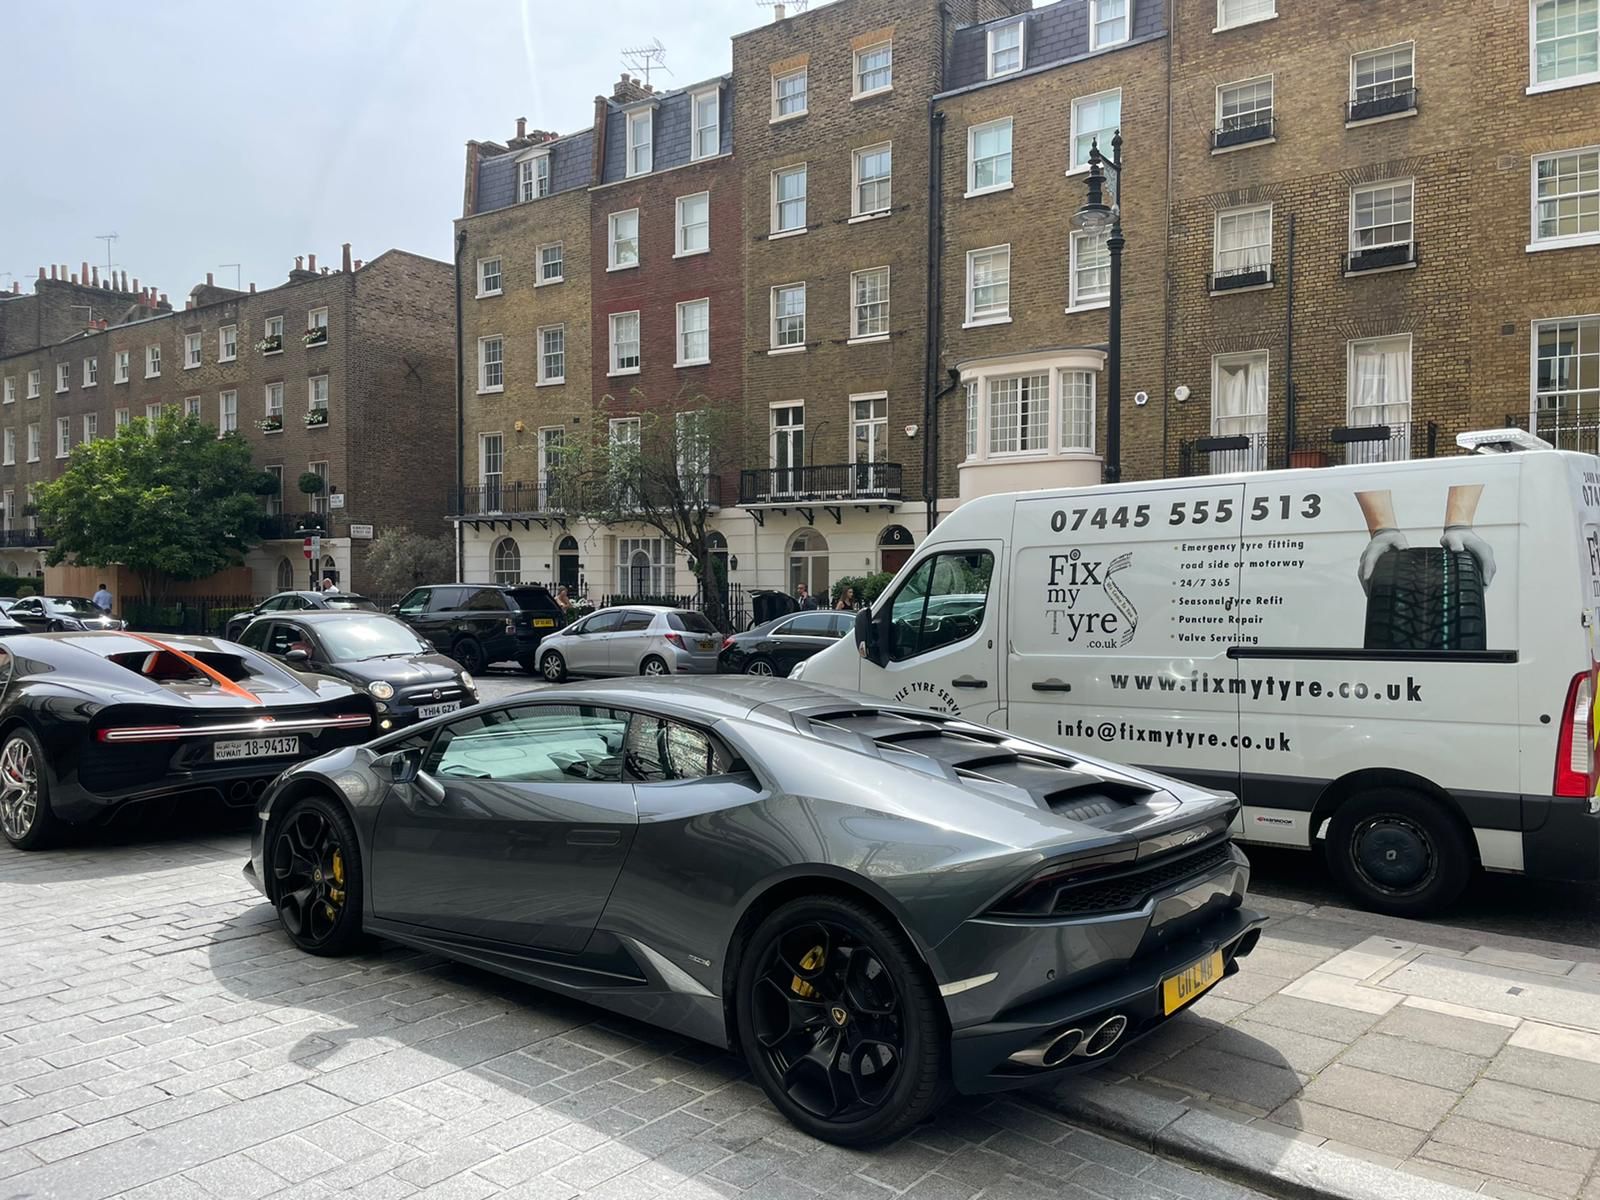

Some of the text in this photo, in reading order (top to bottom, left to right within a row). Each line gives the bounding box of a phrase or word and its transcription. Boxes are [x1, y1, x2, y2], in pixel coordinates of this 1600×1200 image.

[1051, 494, 1322, 532] 07445 555 513
[893, 530, 901, 540] 6
[1181, 539, 1305, 553] Emergency tyre fitting
[1047, 548, 1102, 586] Fix
[1180, 559, 1305, 569] road side or motorway
[1180, 578, 1231, 588] 24/7 365
[1047, 588, 1081, 609] my
[1178, 595, 1283, 607] Seasonal Tyre Refit
[1045, 609, 1118, 642] Tyre
[1178, 614, 1263, 626] Puncture Repair
[1086, 638, 1118, 649] .co.uk
[1178, 633, 1259, 645] Valve Servicing
[911, 682, 936, 693] TYRE
[1110, 670, 1422, 701] www.fixmytyre.co.uk
[1057, 720, 1291, 751] info@fixmytyre.co.uk
[244, 738, 297, 756] 18-94137
[216, 749, 241, 758] KUWAIT
